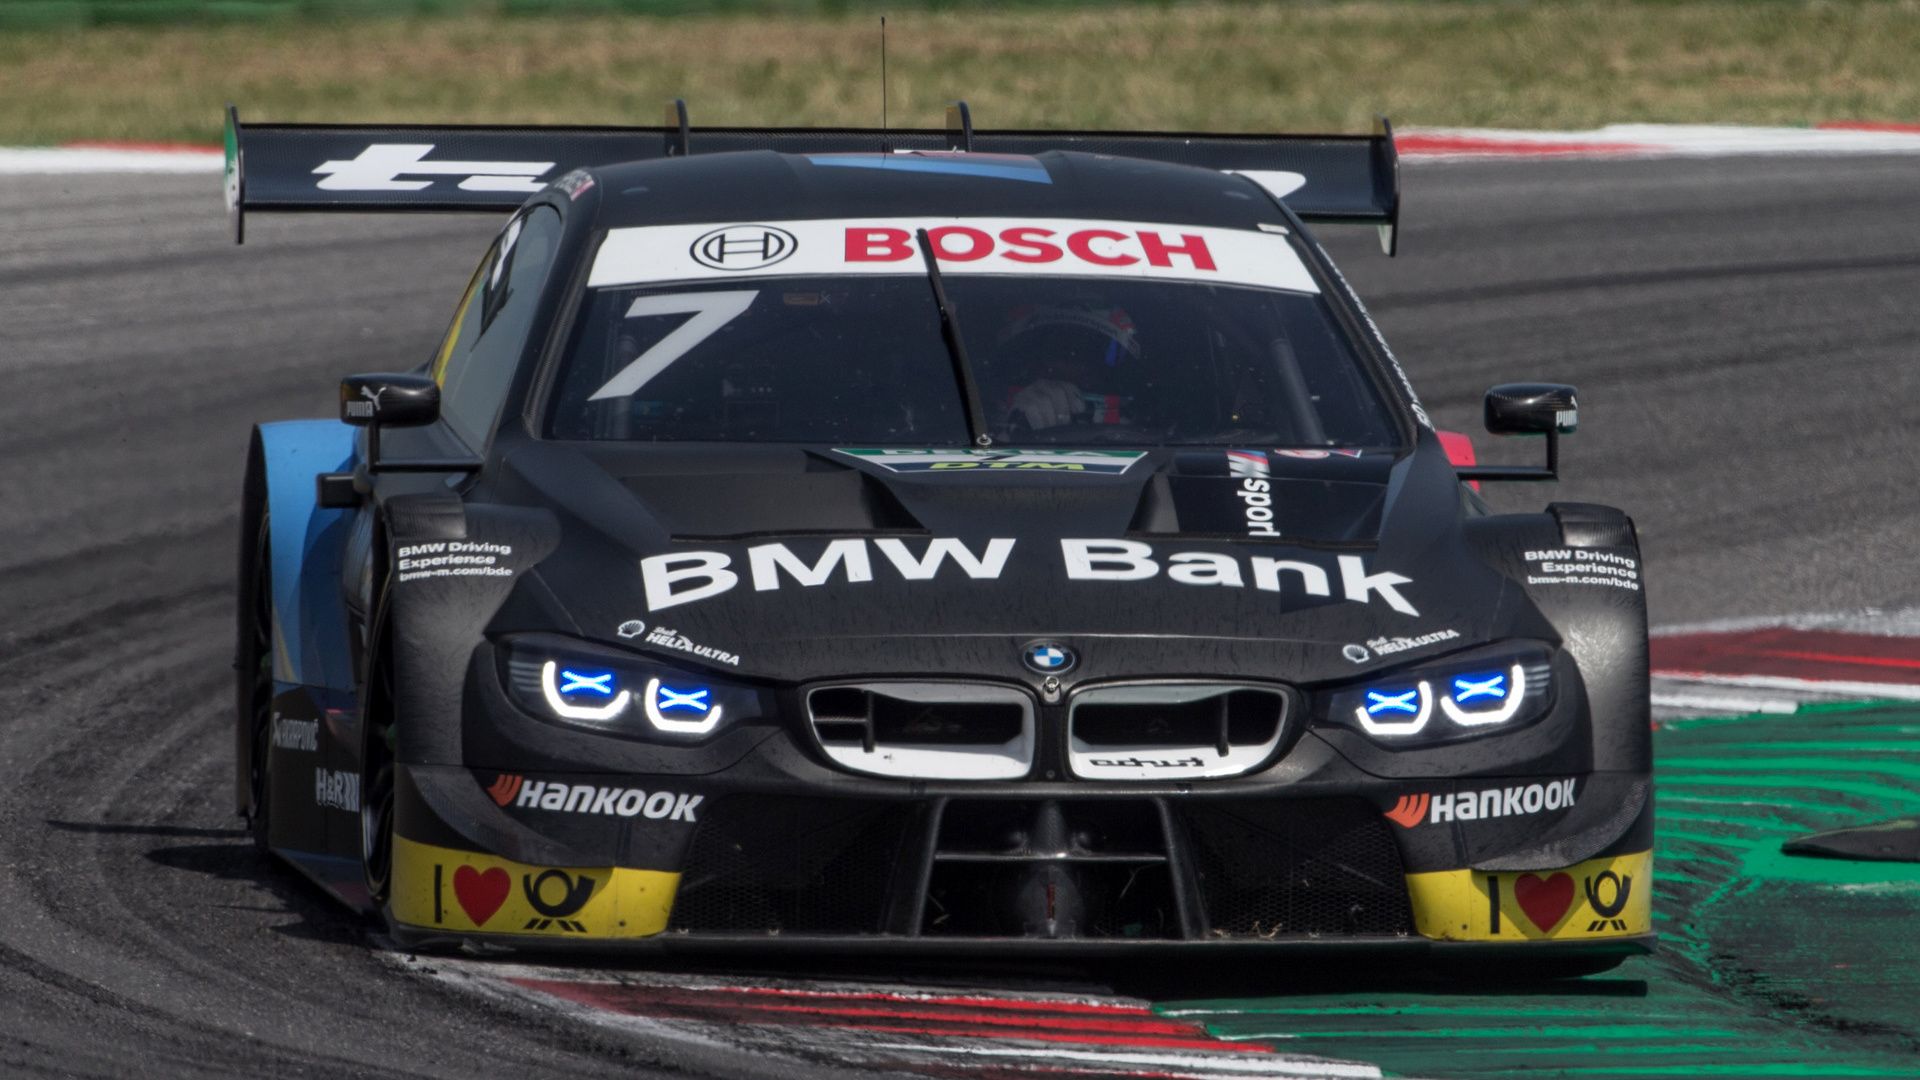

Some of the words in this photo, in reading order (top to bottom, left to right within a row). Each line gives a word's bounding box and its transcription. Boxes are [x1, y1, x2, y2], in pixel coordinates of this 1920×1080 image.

[844, 226, 1217, 271] BOSCH
[587, 290, 760, 401] 7
[928, 461, 1085, 470] DTM
[398, 542, 447, 557] BMW
[448, 541, 512, 556] Driving
[399, 554, 496, 570] Experience
[1524, 549, 1572, 561] BMW
[1574, 550, 1636, 569] Driving
[399, 567, 513, 581] bmw-m.com/bde
[641, 537, 1016, 611] BMW
[1060, 538, 1420, 617] Bank
[1541, 561, 1637, 579] Experience
[1527, 575, 1639, 591] bmw-m.com/bde
[693, 644, 740, 666] ULTRA
